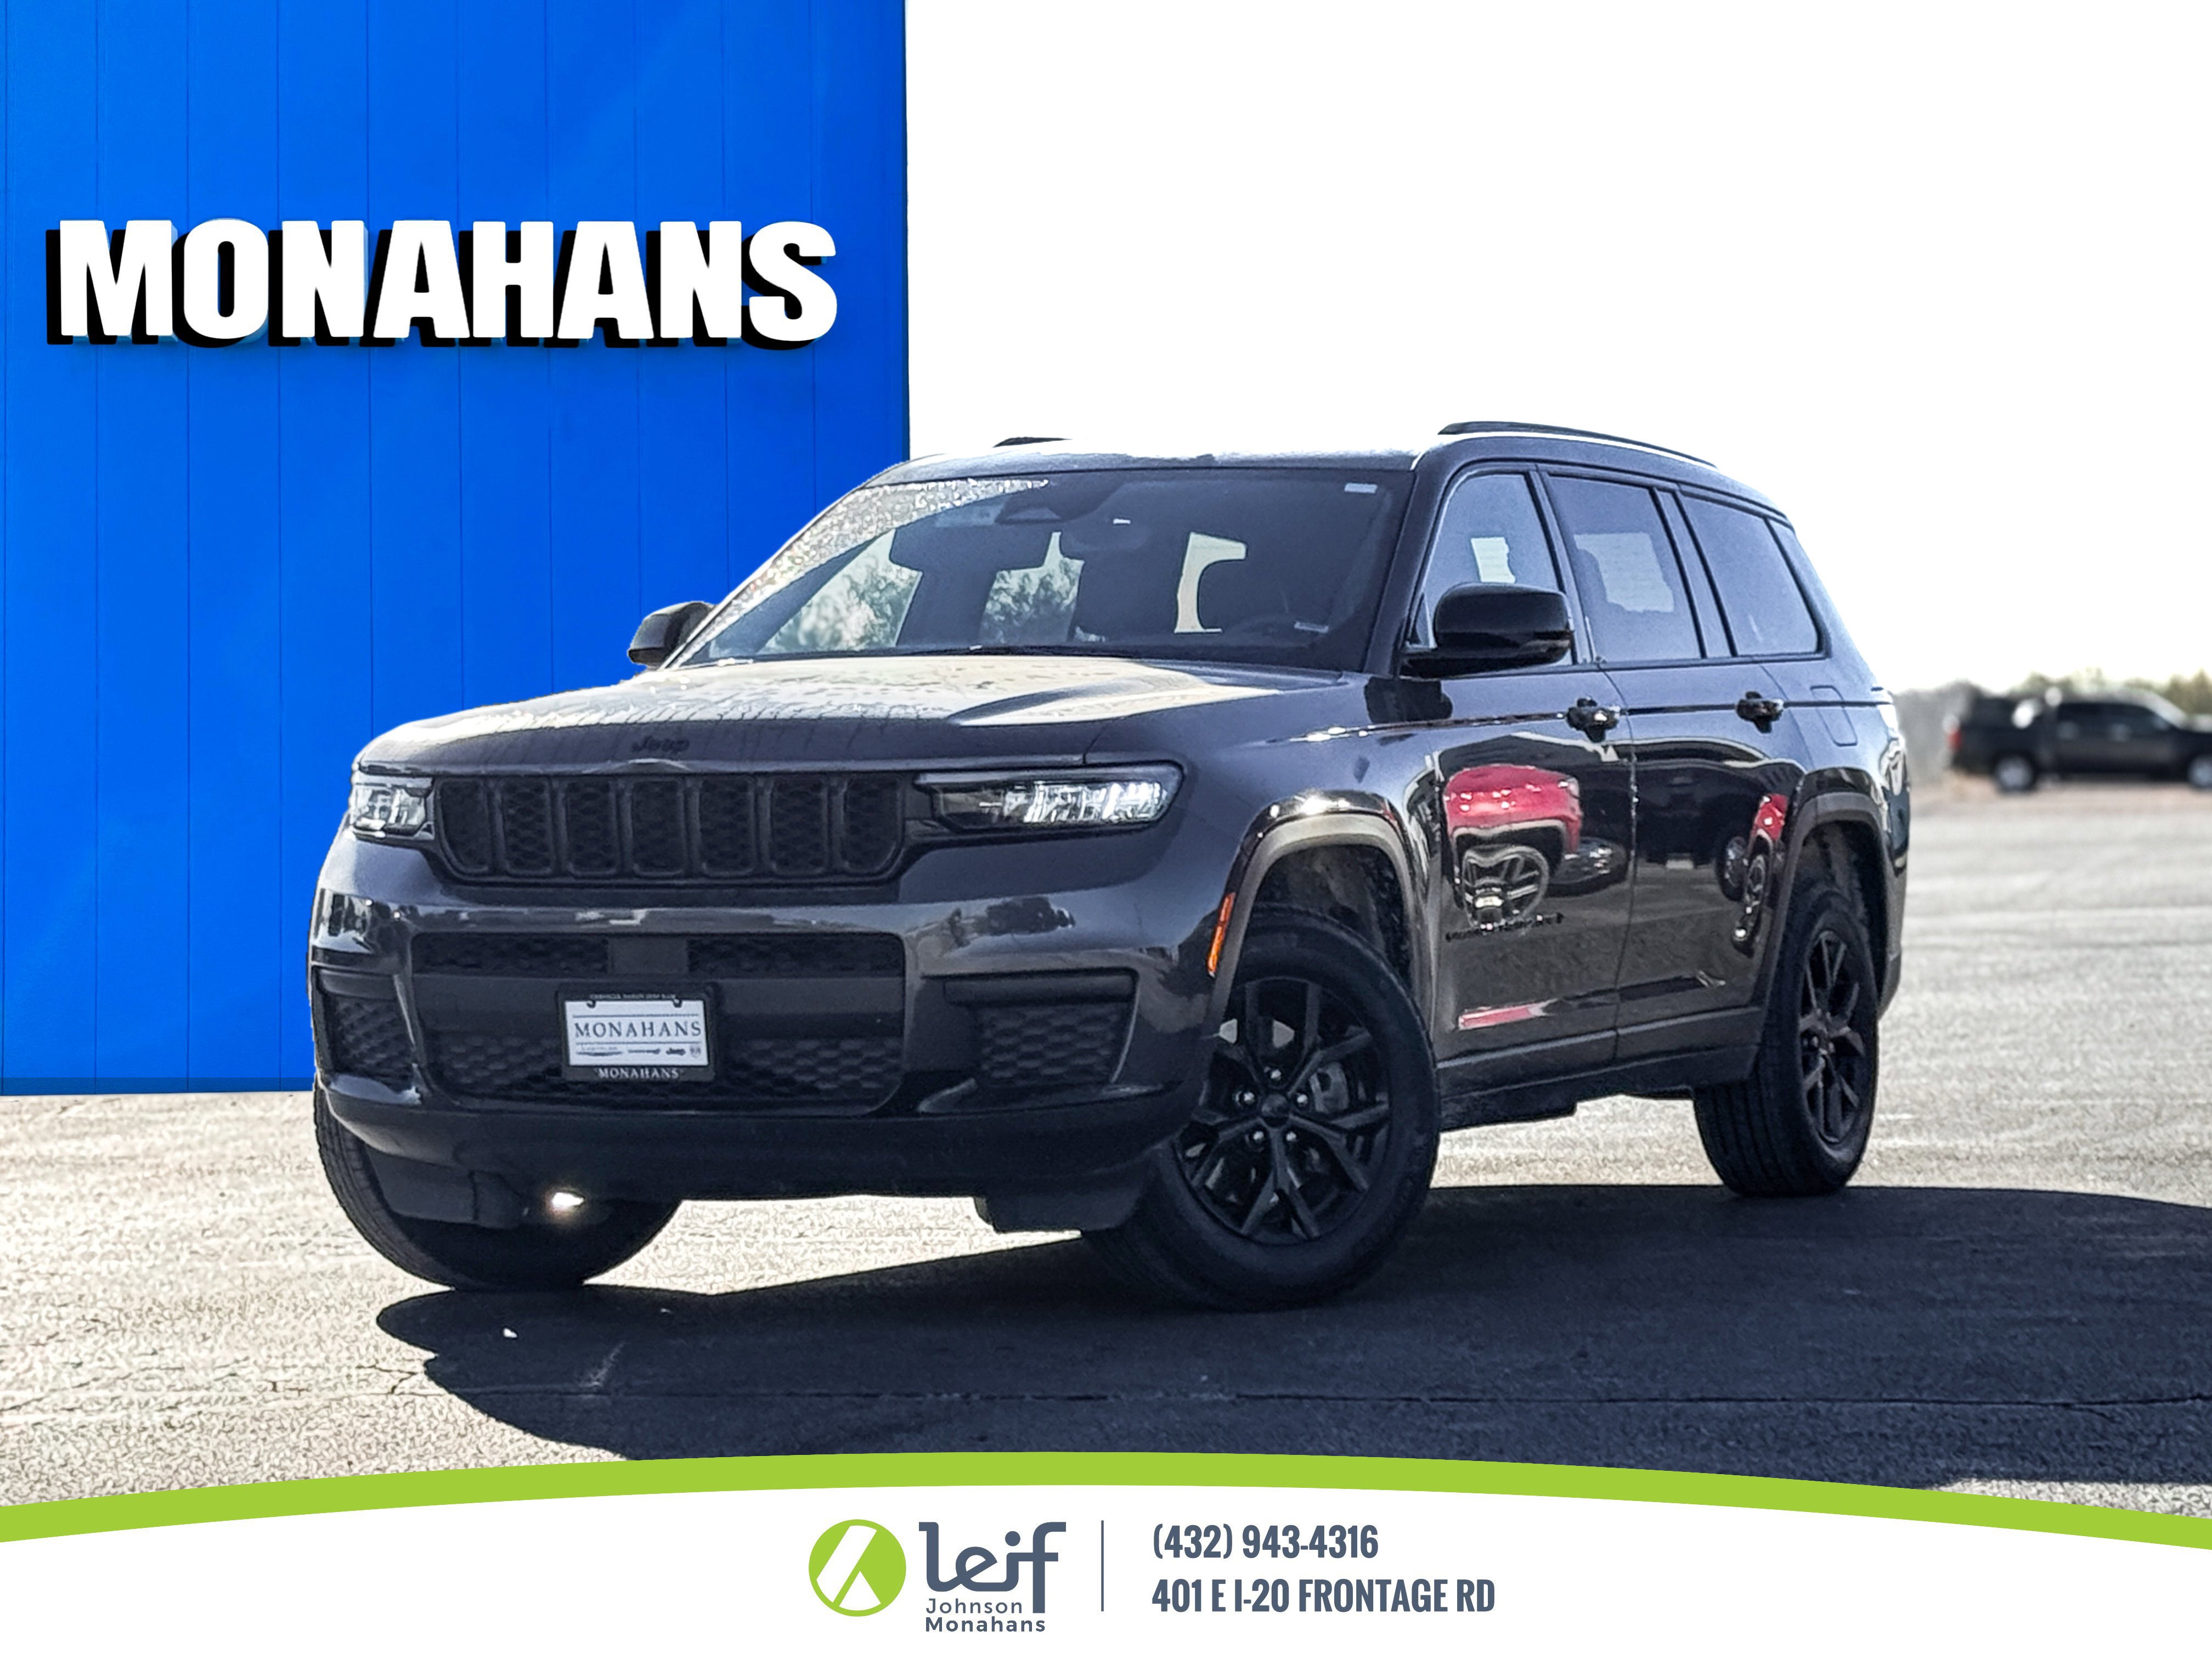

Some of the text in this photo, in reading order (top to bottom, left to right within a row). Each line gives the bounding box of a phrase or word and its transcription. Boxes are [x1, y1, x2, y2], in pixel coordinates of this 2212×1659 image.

[60, 218, 838, 341] MONAHANS
[574, 1020, 701, 1037] MONAHANS
[598, 1068, 679, 1079] MONAHANS
